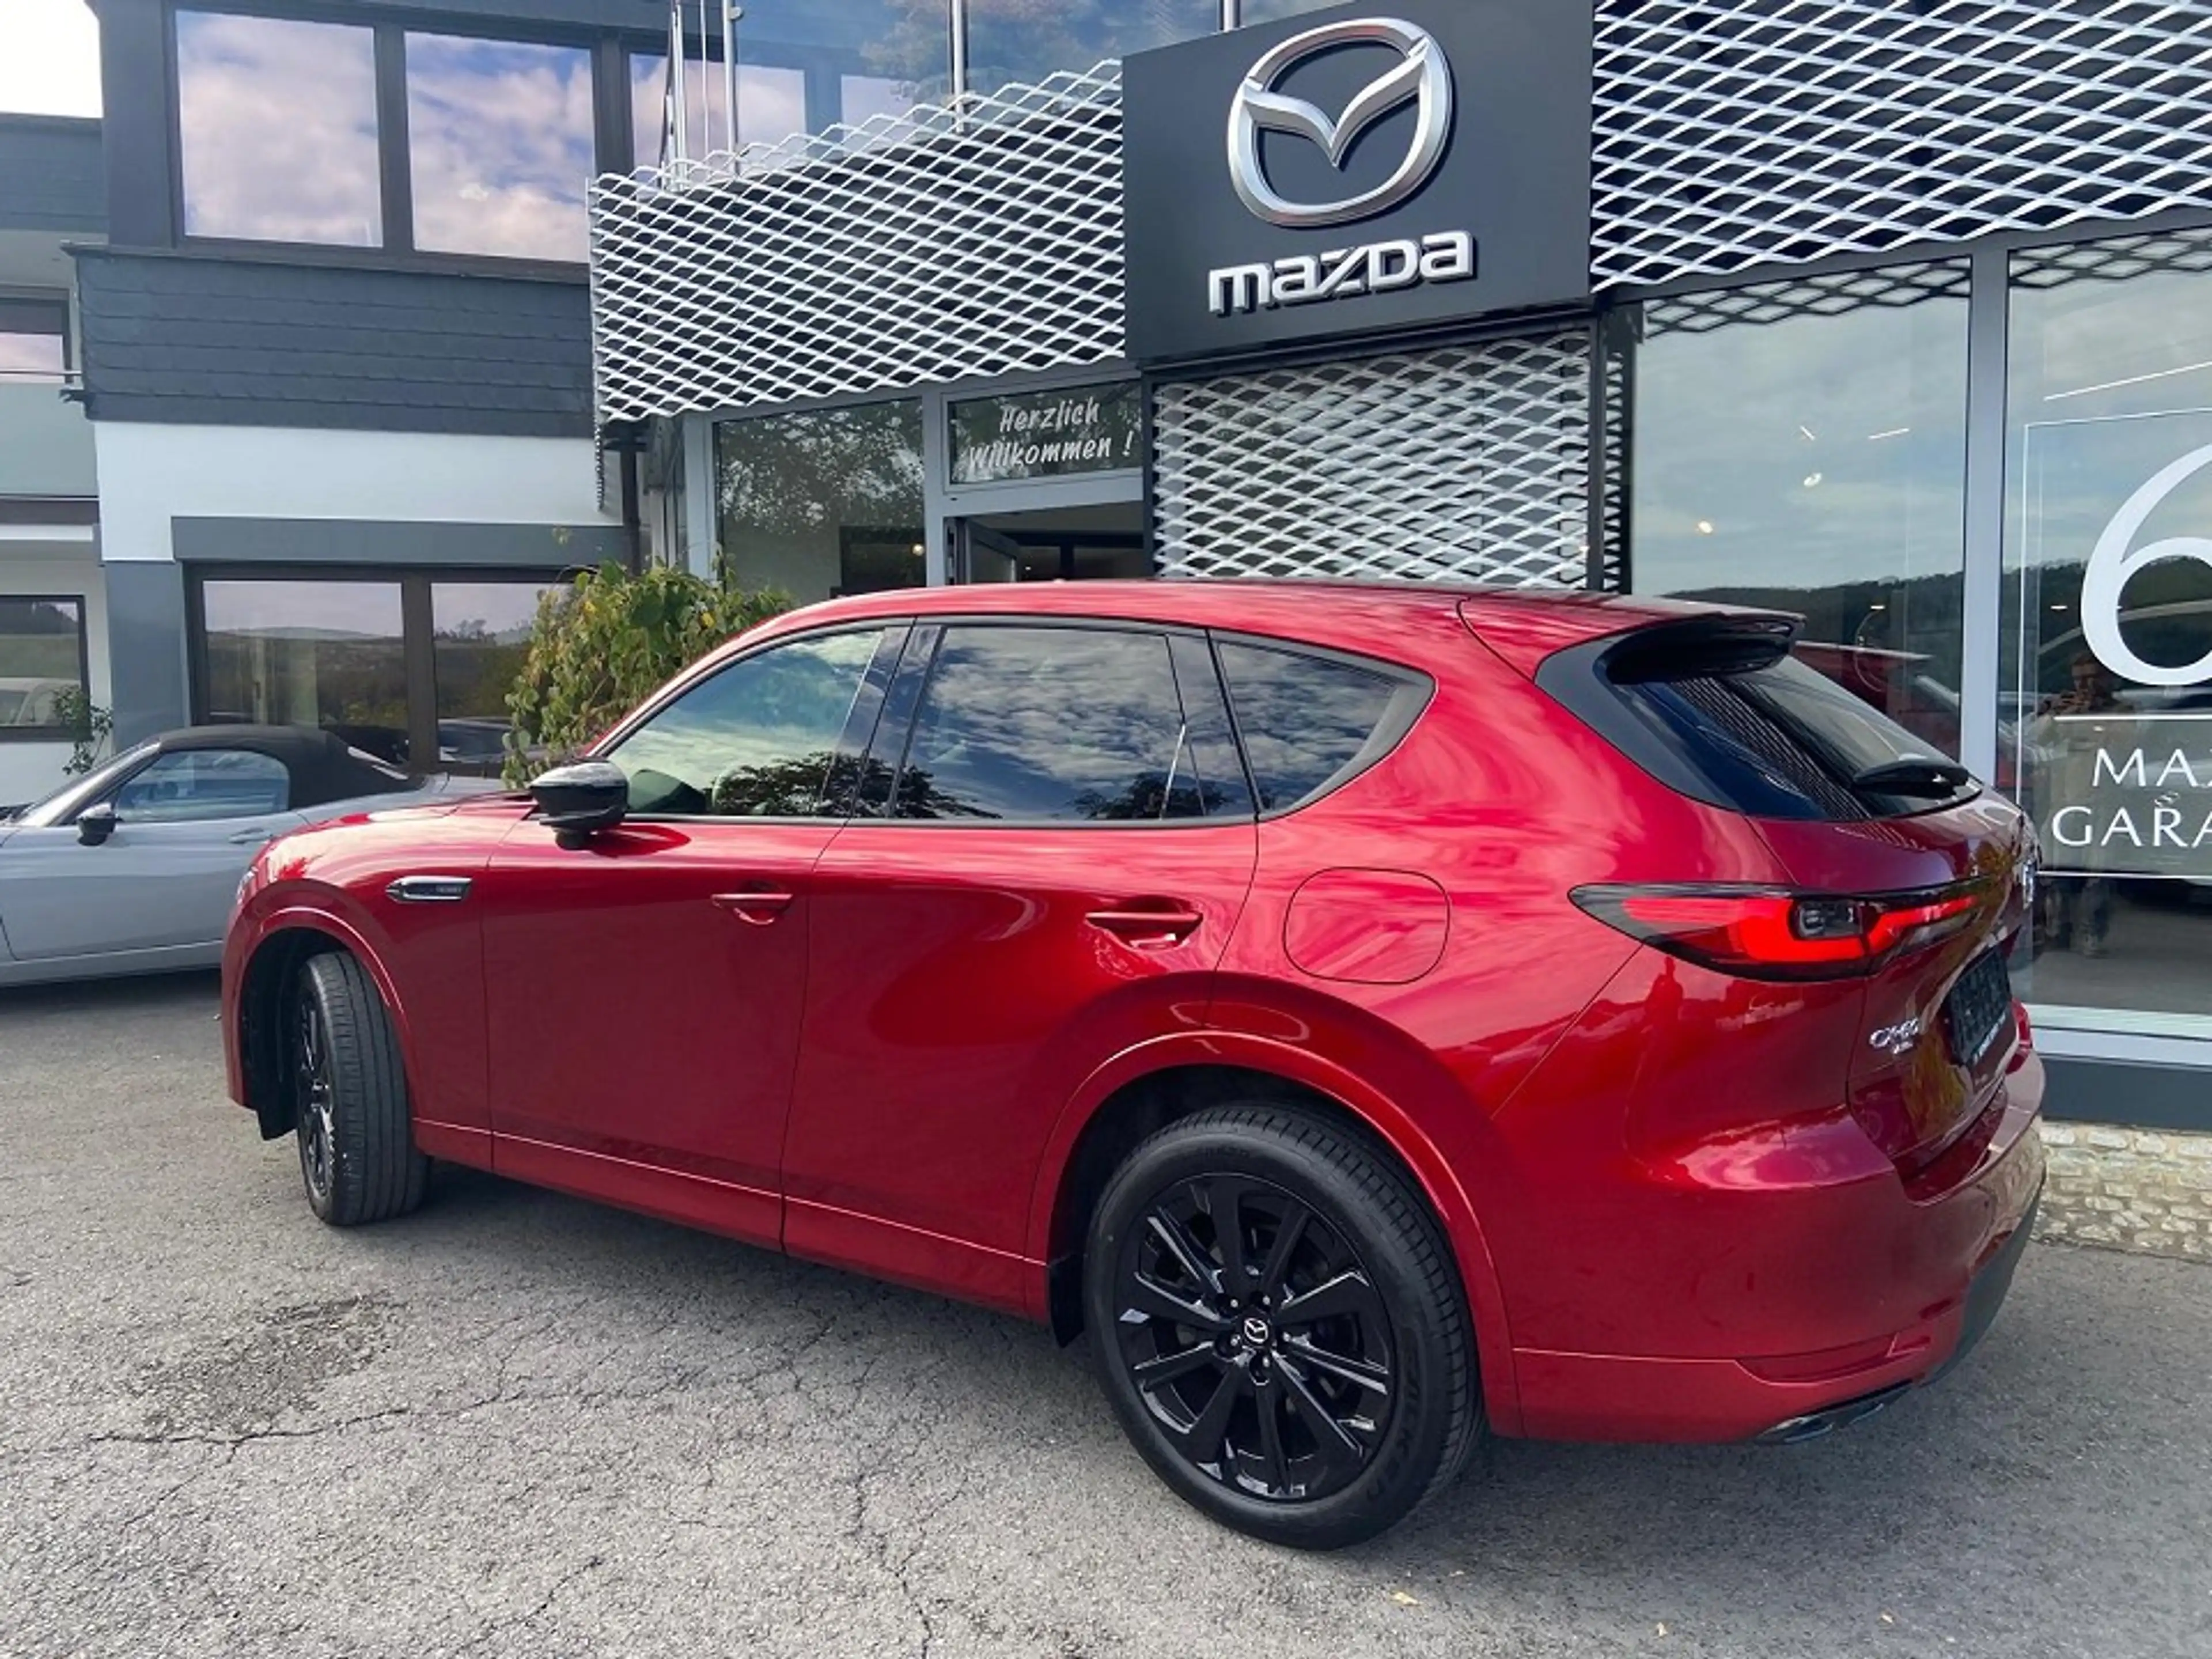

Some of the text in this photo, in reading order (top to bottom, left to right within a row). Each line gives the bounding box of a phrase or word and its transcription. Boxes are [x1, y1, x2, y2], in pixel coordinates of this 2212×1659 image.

[999, 396, 1100, 433] Herzlich
[969, 436, 1112, 471] Willkommen
[2092, 747, 2212, 787] MA
